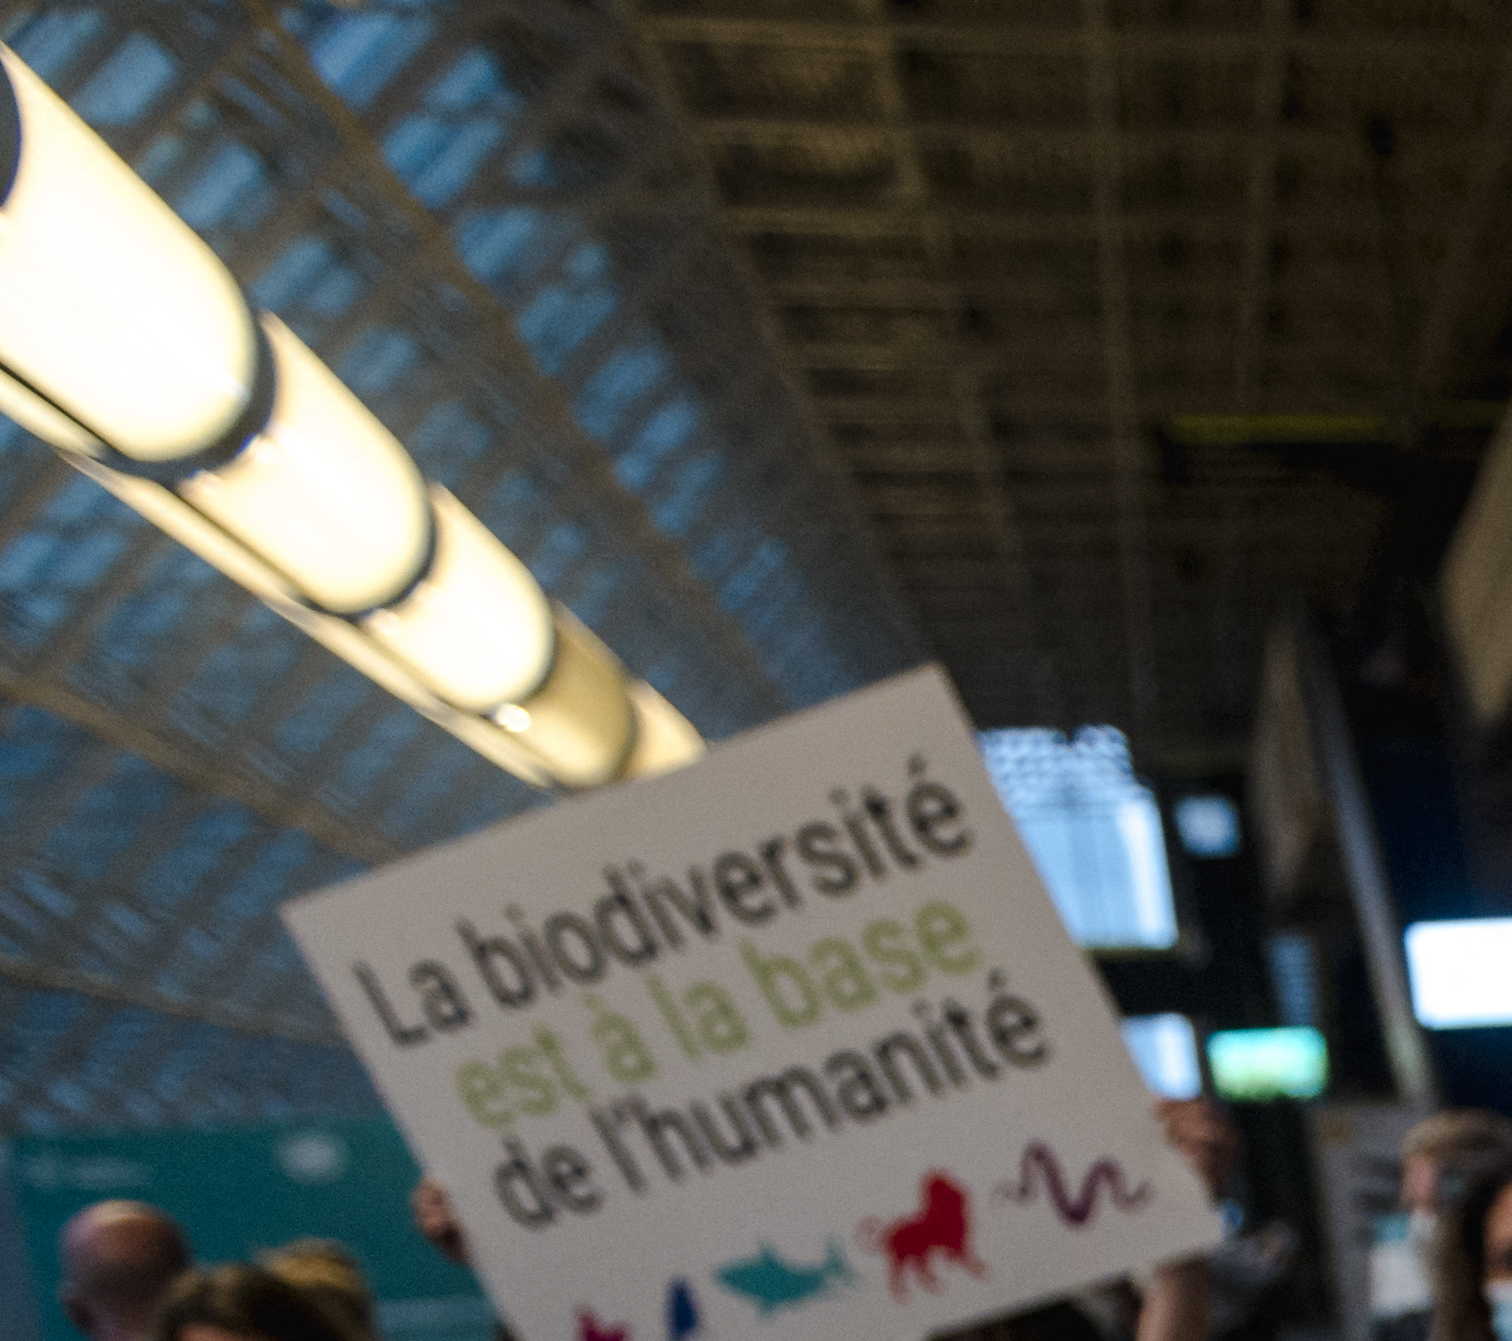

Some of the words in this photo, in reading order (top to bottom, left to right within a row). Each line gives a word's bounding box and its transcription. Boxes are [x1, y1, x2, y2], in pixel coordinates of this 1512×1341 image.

[355, 962, 470, 1049] La
[457, 754, 975, 1000] biodiversité
[457, 1038, 589, 1128] est
[591, 985, 650, 1084] à
[650, 967, 747, 1061] la
[739, 896, 983, 1030] base
[493, 1132, 599, 1231] de
[594, 969, 1051, 1191] l'humanité
